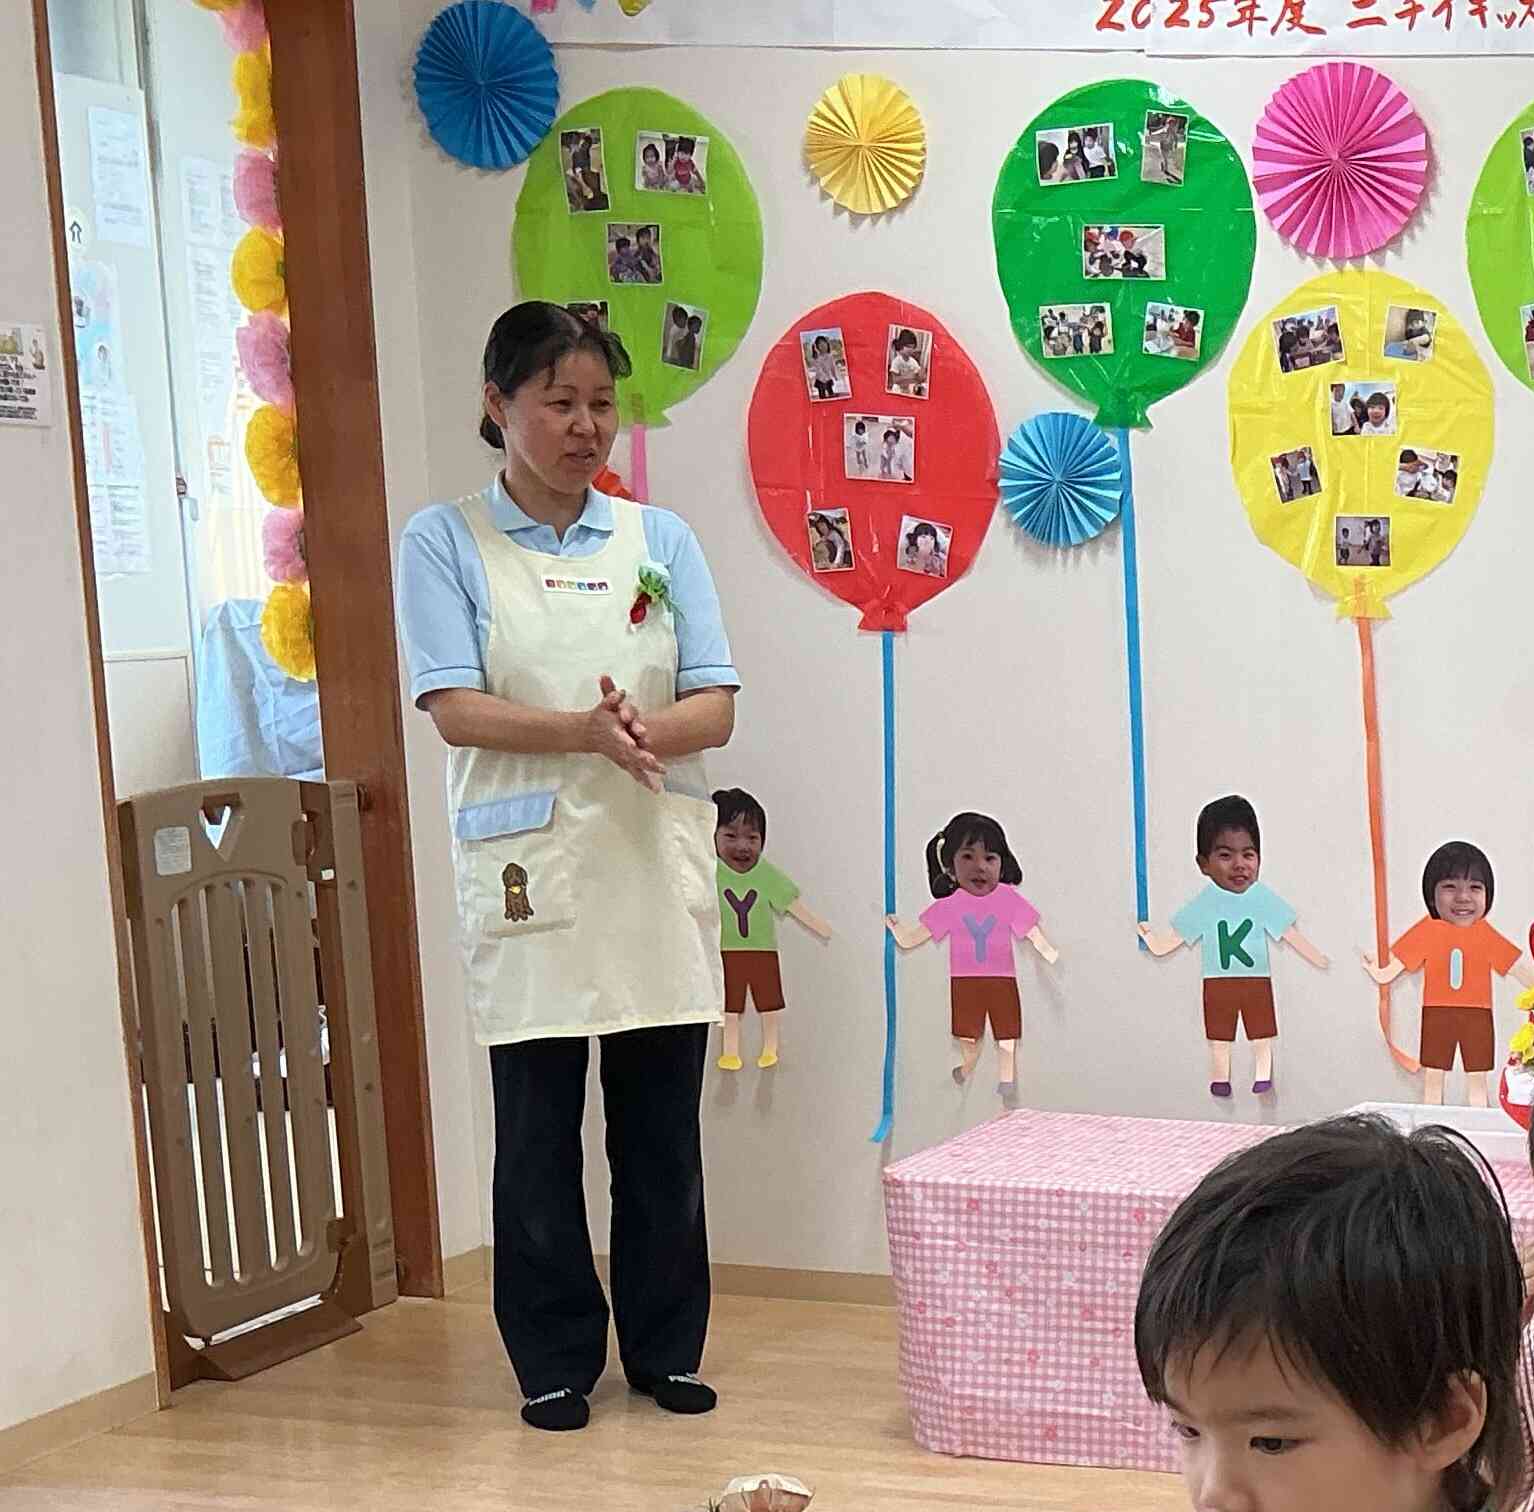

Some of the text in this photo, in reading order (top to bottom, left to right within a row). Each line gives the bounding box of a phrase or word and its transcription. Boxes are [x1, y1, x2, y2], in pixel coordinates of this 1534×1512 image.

[724, 888, 758, 938] Y
[962, 913, 998, 963] Y
[1216, 917, 1256, 970] K
